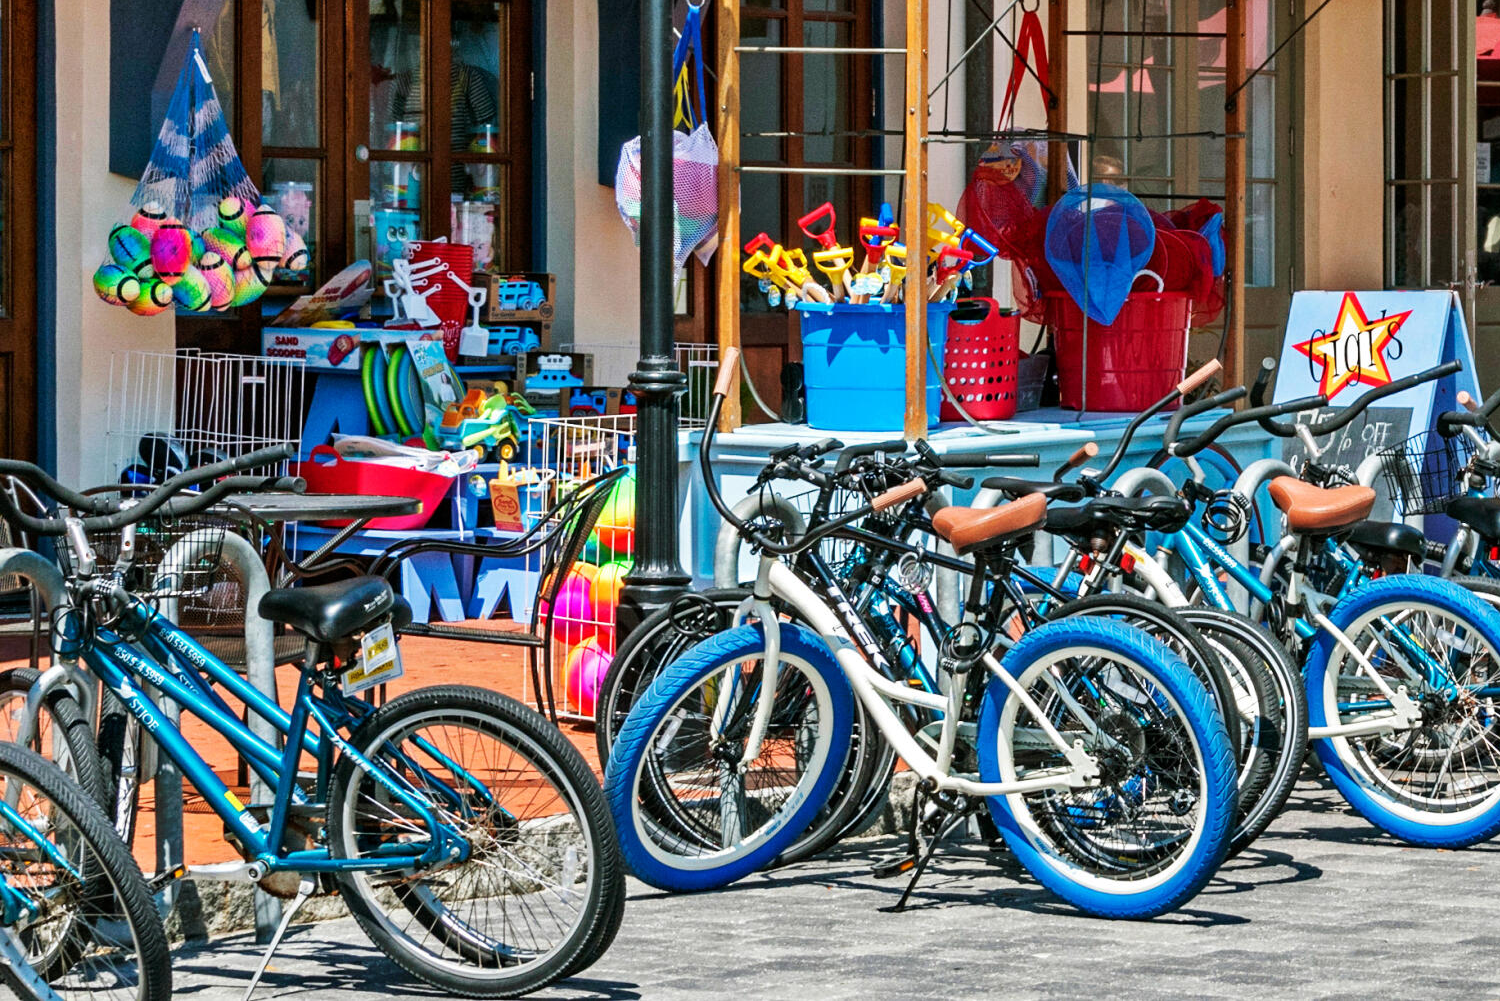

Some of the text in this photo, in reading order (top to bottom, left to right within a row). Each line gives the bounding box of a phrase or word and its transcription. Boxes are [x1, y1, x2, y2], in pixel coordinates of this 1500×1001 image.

[275, 335, 299, 346] SAND
[266, 347, 307, 359] SCOOPER
[827, 582, 891, 669] TREK
